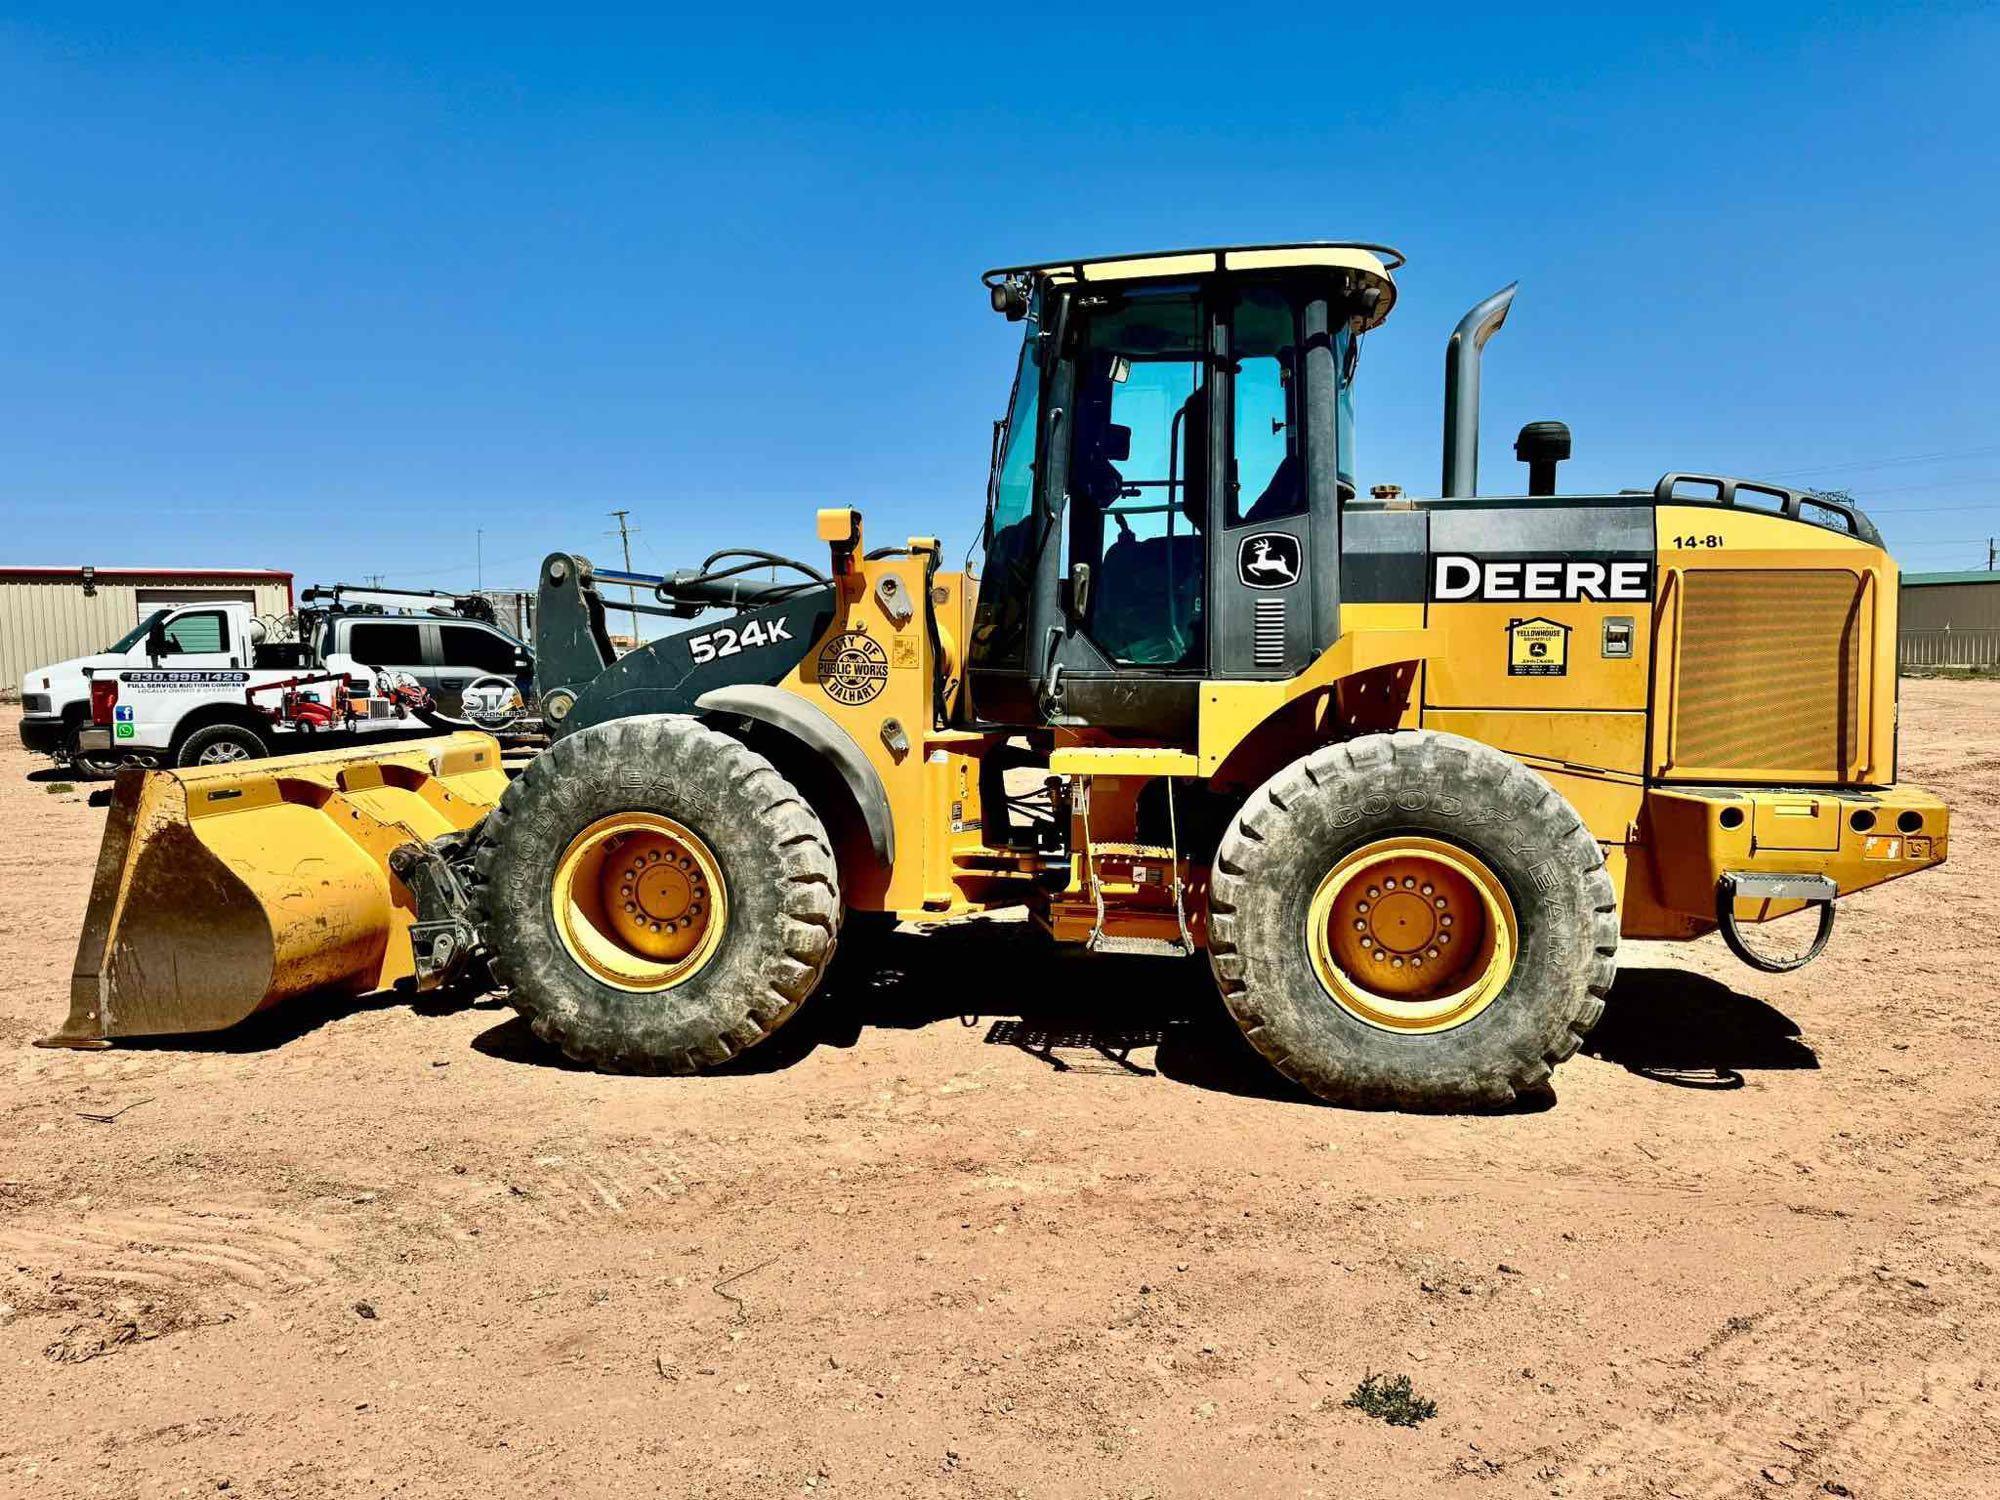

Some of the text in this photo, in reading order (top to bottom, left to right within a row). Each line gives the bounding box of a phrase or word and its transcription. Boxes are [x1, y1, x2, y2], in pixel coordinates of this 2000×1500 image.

[1435, 556, 1648, 599] DEERE
[688, 616, 793, 663] 524K
[827, 637, 879, 655] CITY OF
[818, 663, 888, 676] PUBLIC WORKS
[828, 682, 876, 701] DALHART
